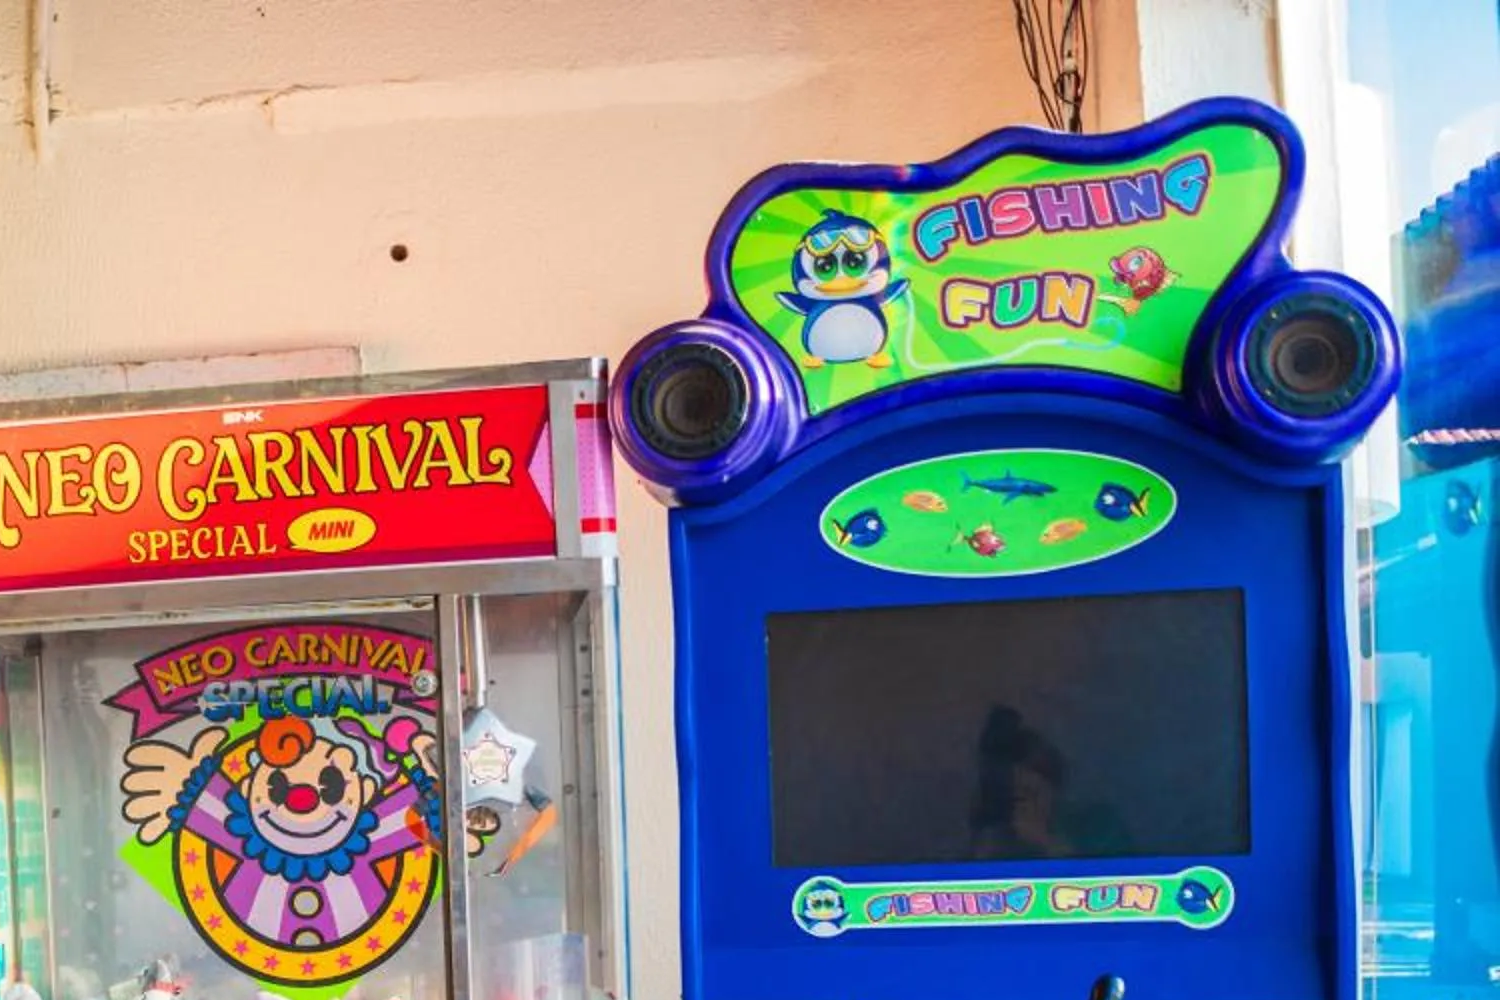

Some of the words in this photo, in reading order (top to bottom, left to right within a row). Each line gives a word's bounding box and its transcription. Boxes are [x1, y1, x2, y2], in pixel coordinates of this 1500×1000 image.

[914, 155, 1210, 261] FISHING
[942, 271, 1094, 328] FUN
[156, 415, 513, 522] CARNIVAL
[129, 522, 277, 564] SPECIAL
[307, 518, 356, 541] MINI
[152, 646, 234, 694] NEO
[245, 632, 426, 675] CARNIVAL
[202, 674, 393, 721] SPECIAL
[866, 884, 1033, 922] FISHING
[1051, 883, 1157, 912] FUN
